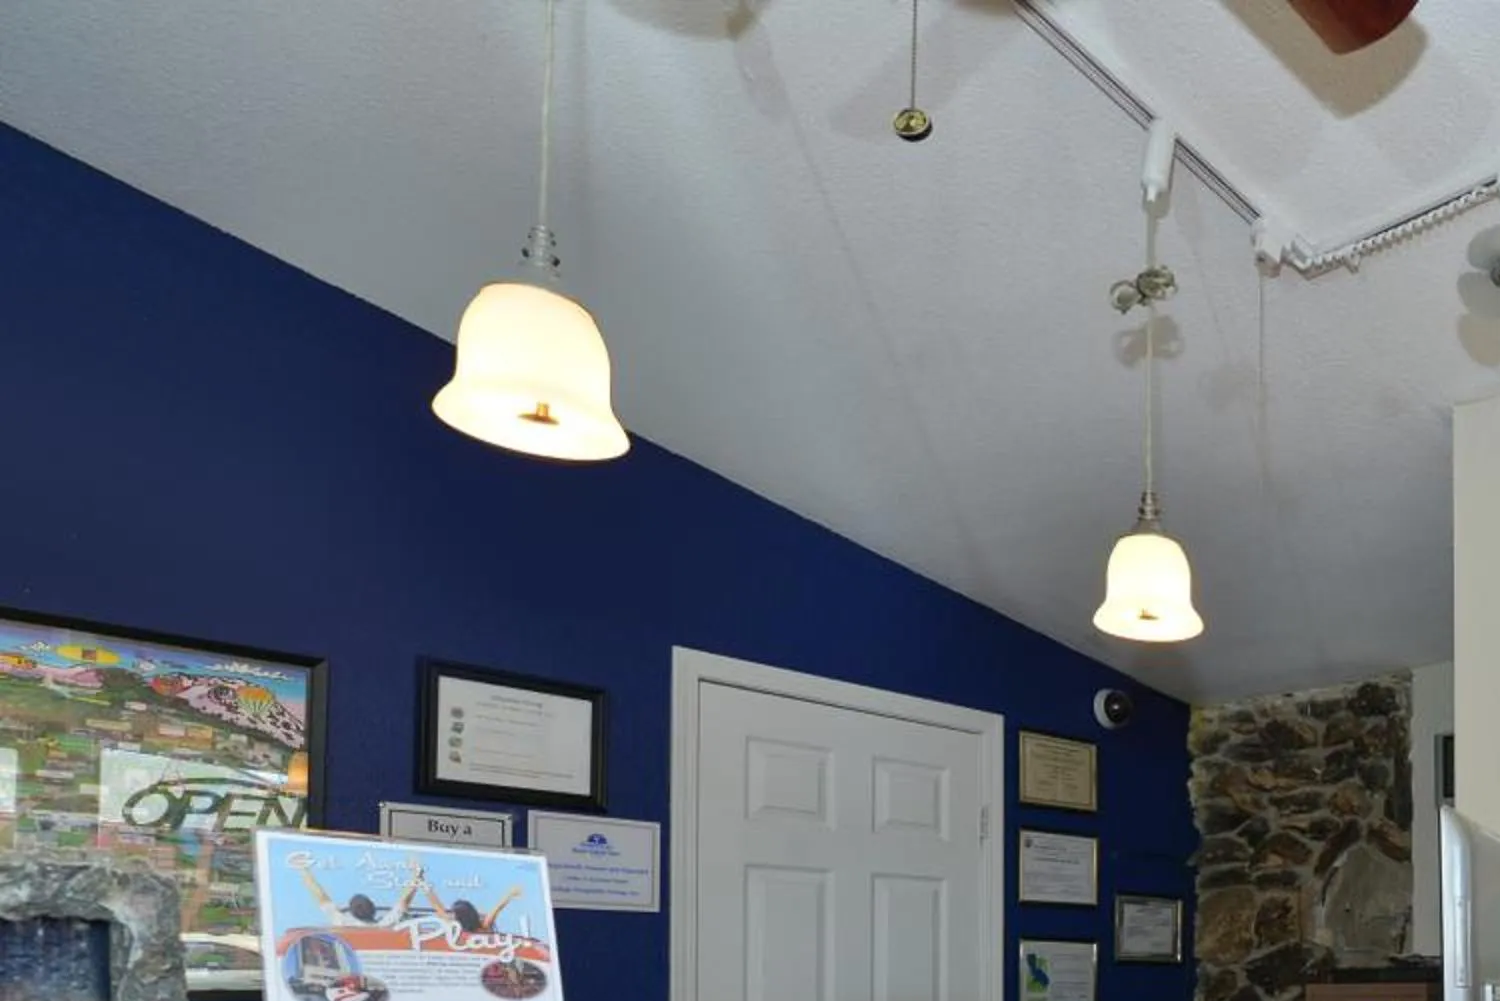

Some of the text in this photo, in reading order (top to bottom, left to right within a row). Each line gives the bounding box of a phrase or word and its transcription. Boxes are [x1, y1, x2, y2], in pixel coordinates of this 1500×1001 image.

[122, 782, 308, 832] OPEN
[427, 819, 472, 836] Buy a
[394, 914, 531, 962] Play!
